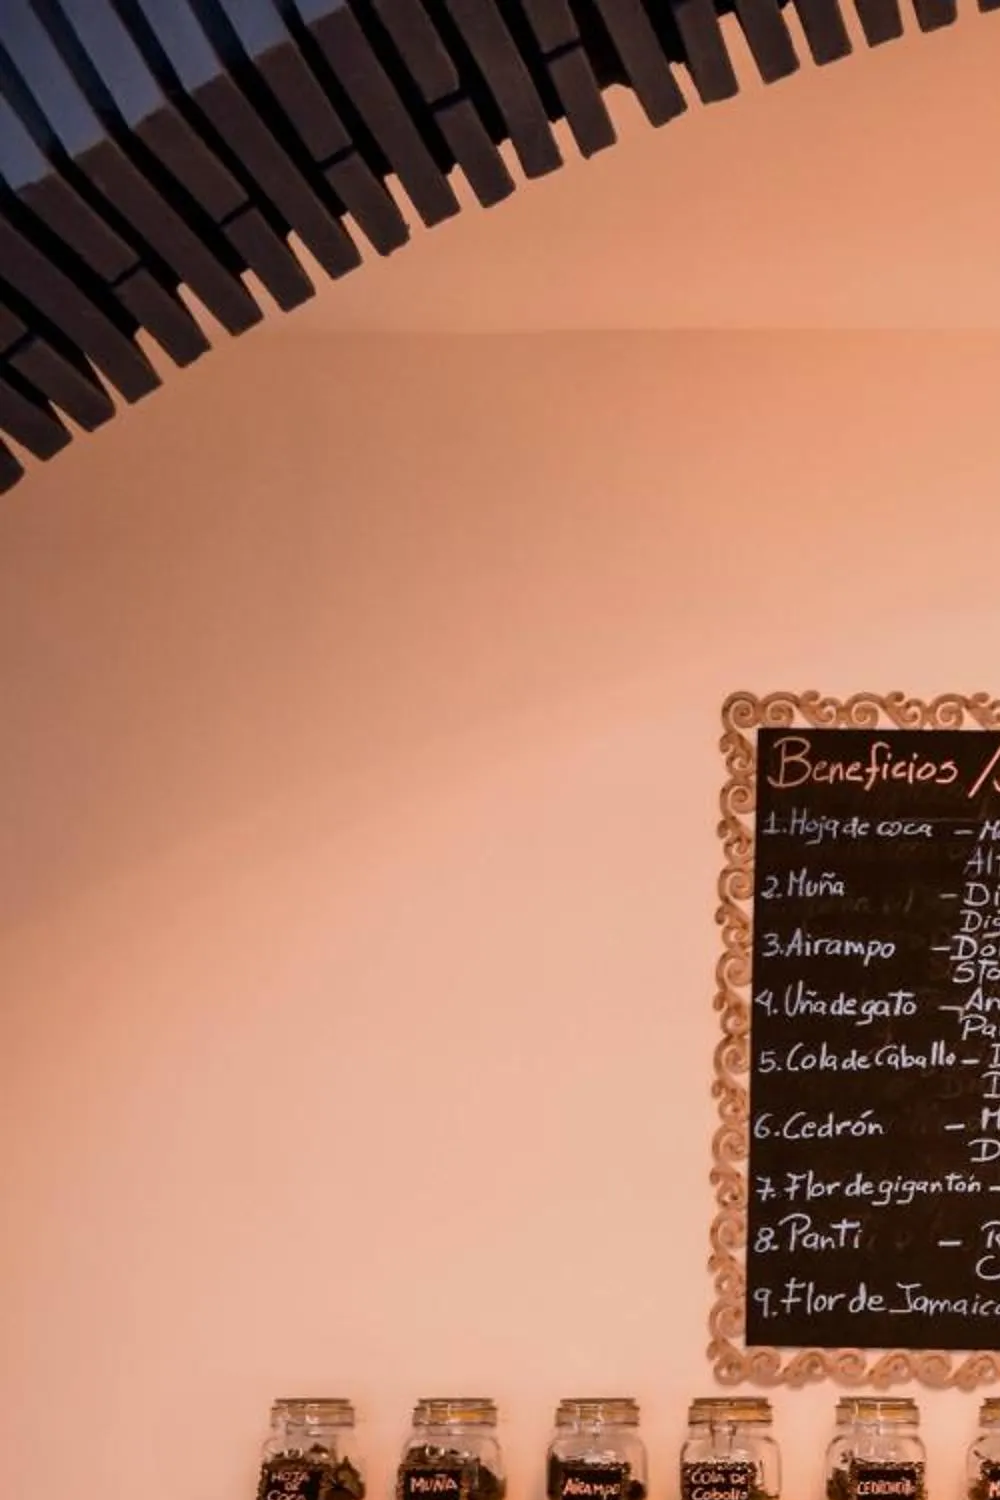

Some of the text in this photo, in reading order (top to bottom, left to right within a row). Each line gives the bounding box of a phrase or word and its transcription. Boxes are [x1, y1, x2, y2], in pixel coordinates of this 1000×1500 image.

[768, 736, 958, 791] Beneficios
[843, 816, 870, 839] de
[876, 821, 933, 838] coca
[830, 992, 857, 1015] de
[841, 1049, 871, 1071] de
[783, 1169, 842, 1201] Flor
[845, 1172, 874, 1197] de
[780, 1277, 846, 1315] Flor
[849, 1282, 887, 1313] de
